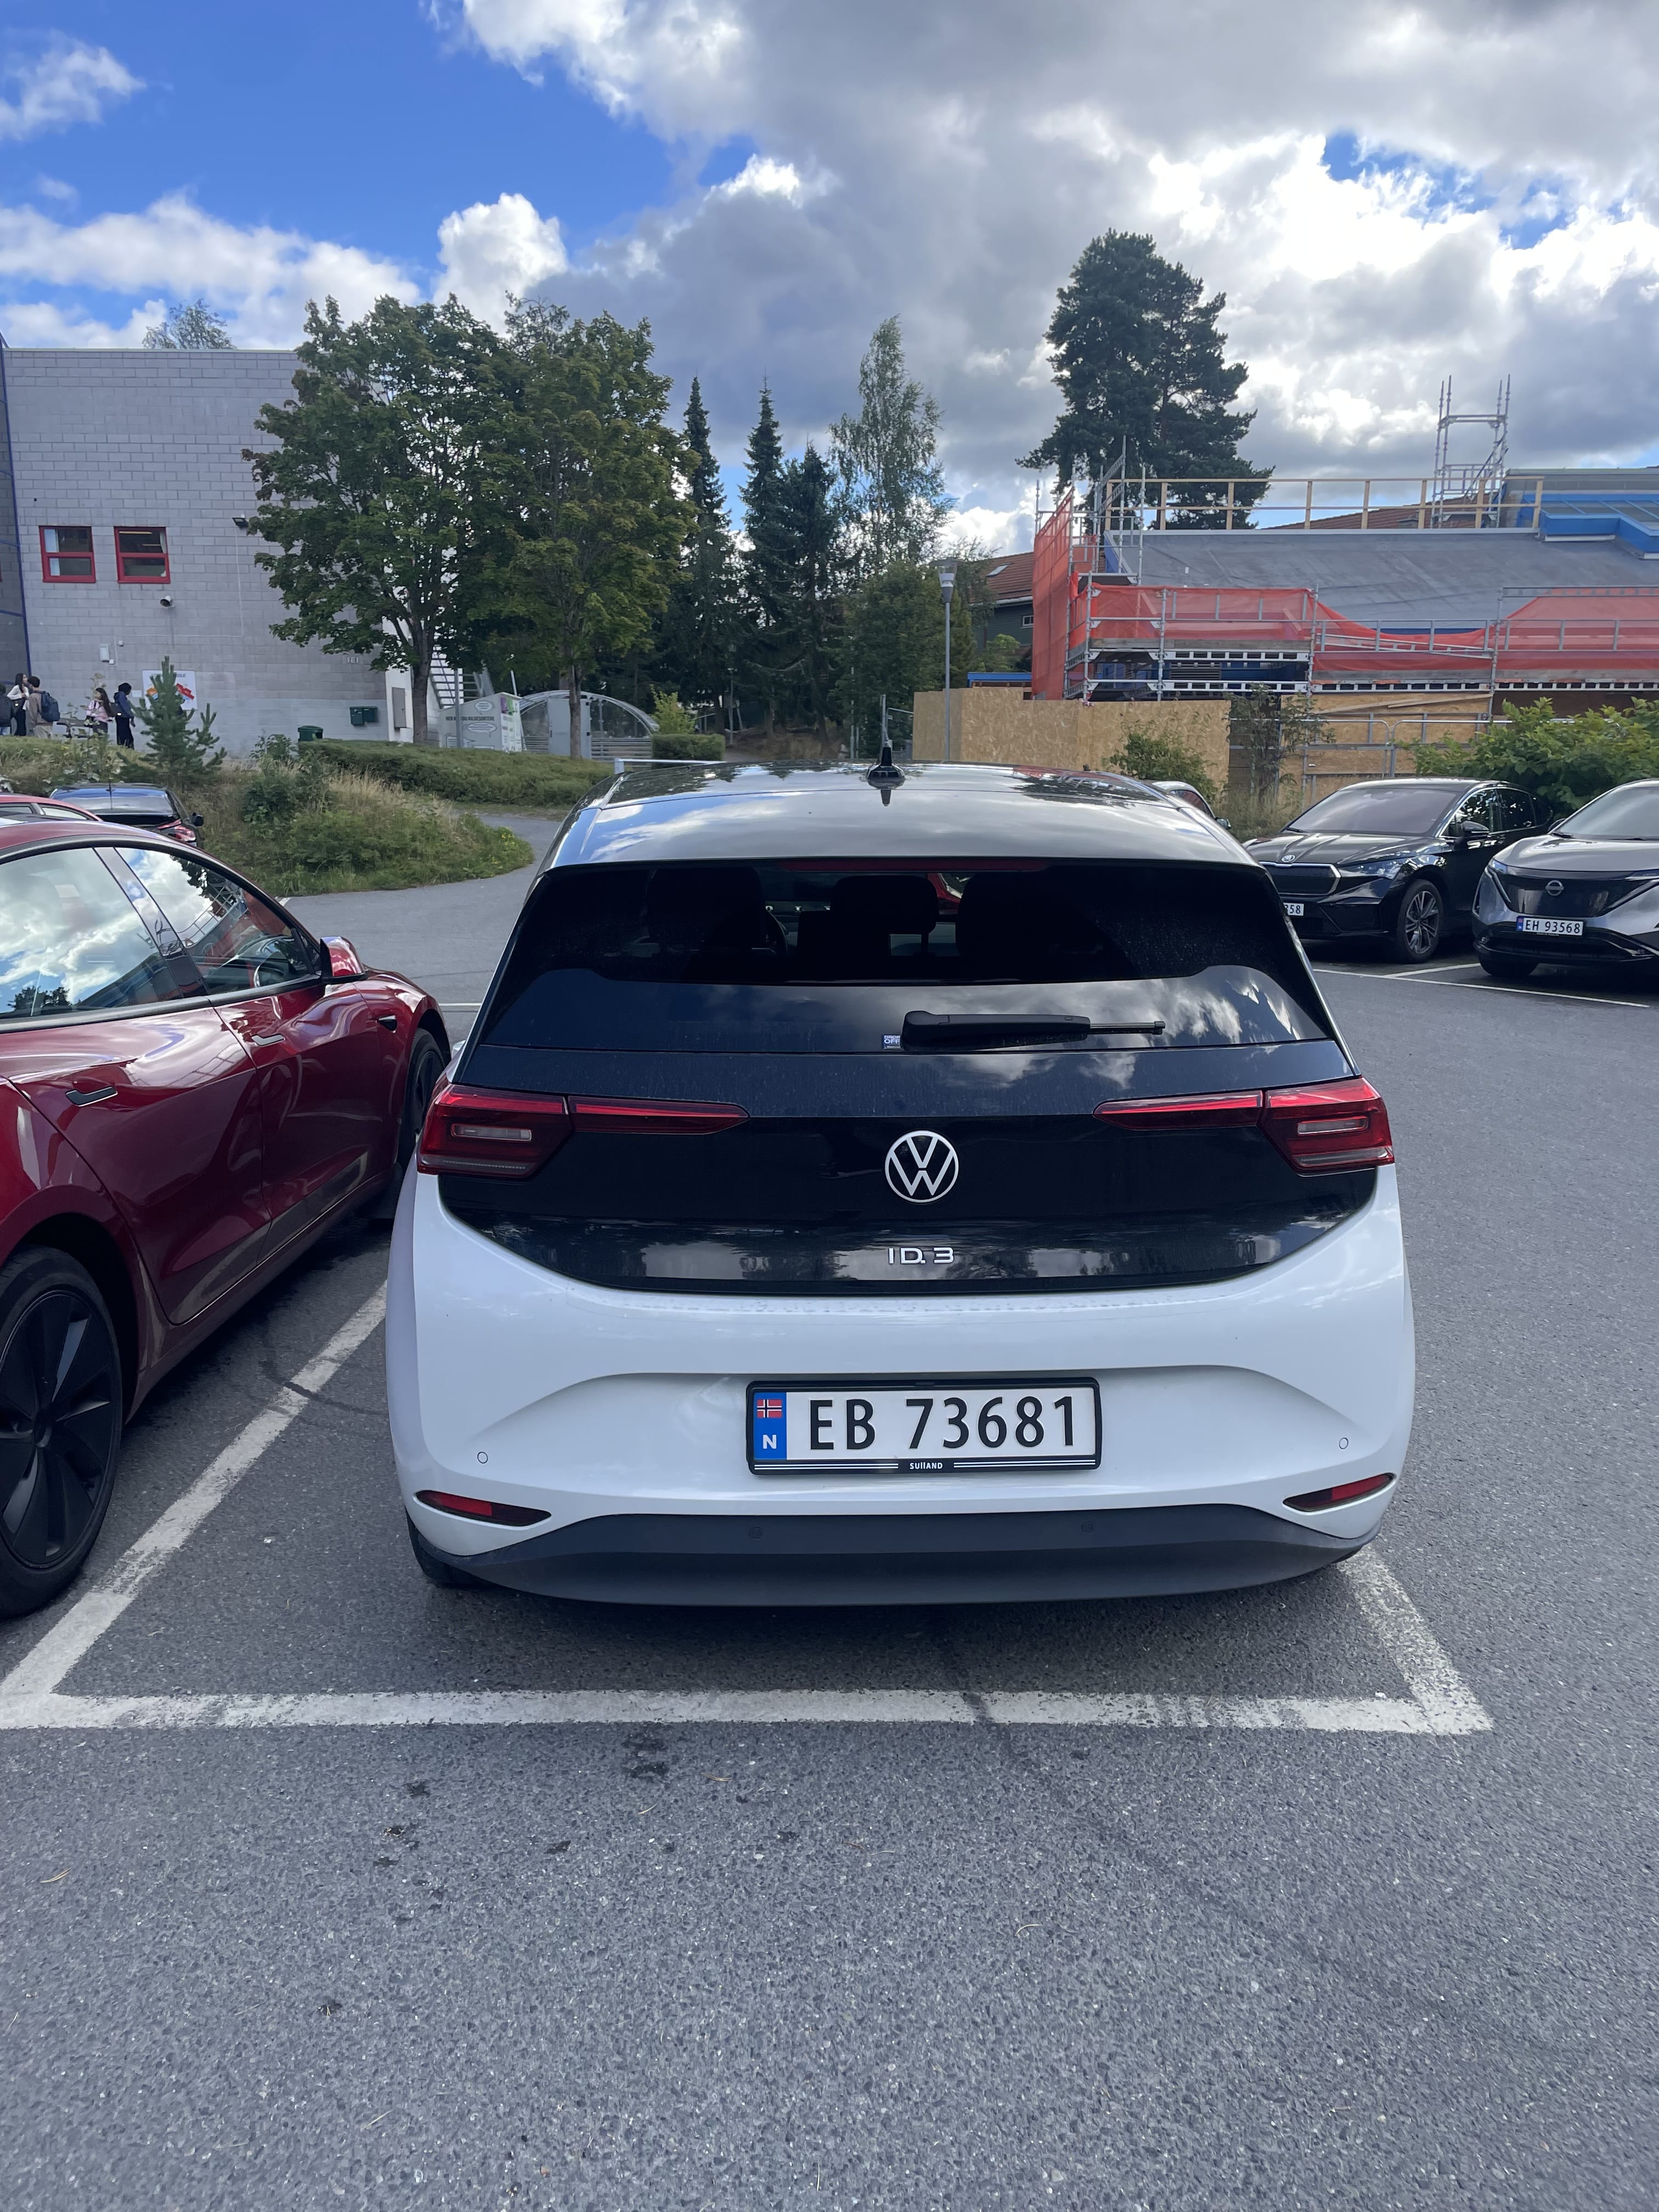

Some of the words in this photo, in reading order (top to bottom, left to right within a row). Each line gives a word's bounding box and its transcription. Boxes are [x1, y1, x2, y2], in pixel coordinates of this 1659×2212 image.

[1525, 919, 1539, 931] EH
[1545, 921, 1580, 933] 93568
[888, 1247, 954, 1264] ID.3
[810, 1399, 875, 1450] EB
[906, 1396, 1073, 1449] 73681
[763, 1434, 777, 1449] N
